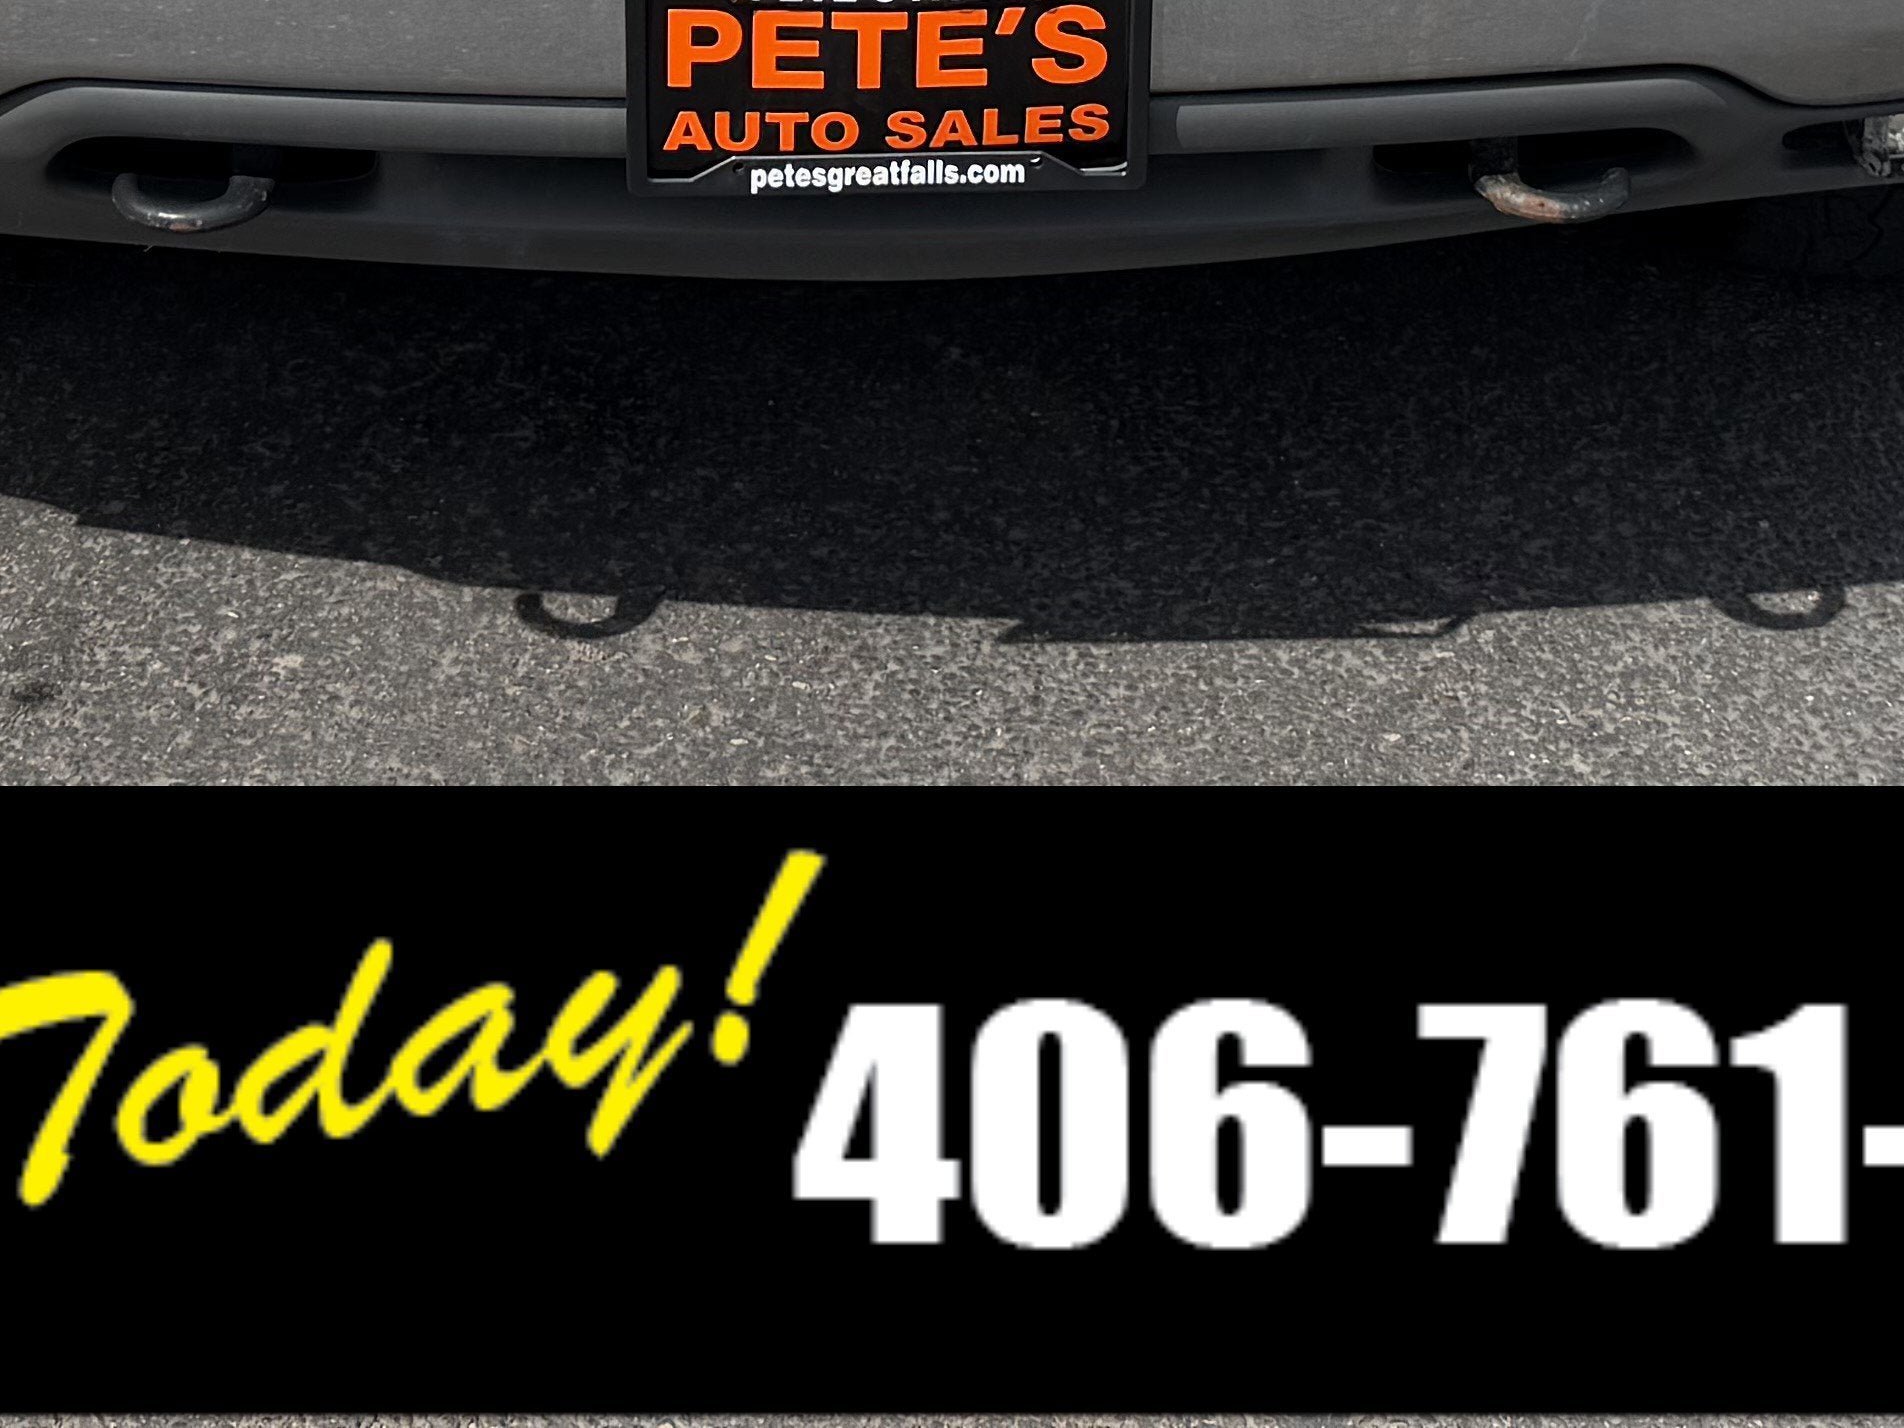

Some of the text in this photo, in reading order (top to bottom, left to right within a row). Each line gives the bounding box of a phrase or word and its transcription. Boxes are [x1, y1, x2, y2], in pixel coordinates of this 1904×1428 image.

[667, 4, 1109, 90] PETE'S
[662, 103, 1111, 152] AUTO SALES
[749, 157, 1026, 195] petesgreatfalls.com
